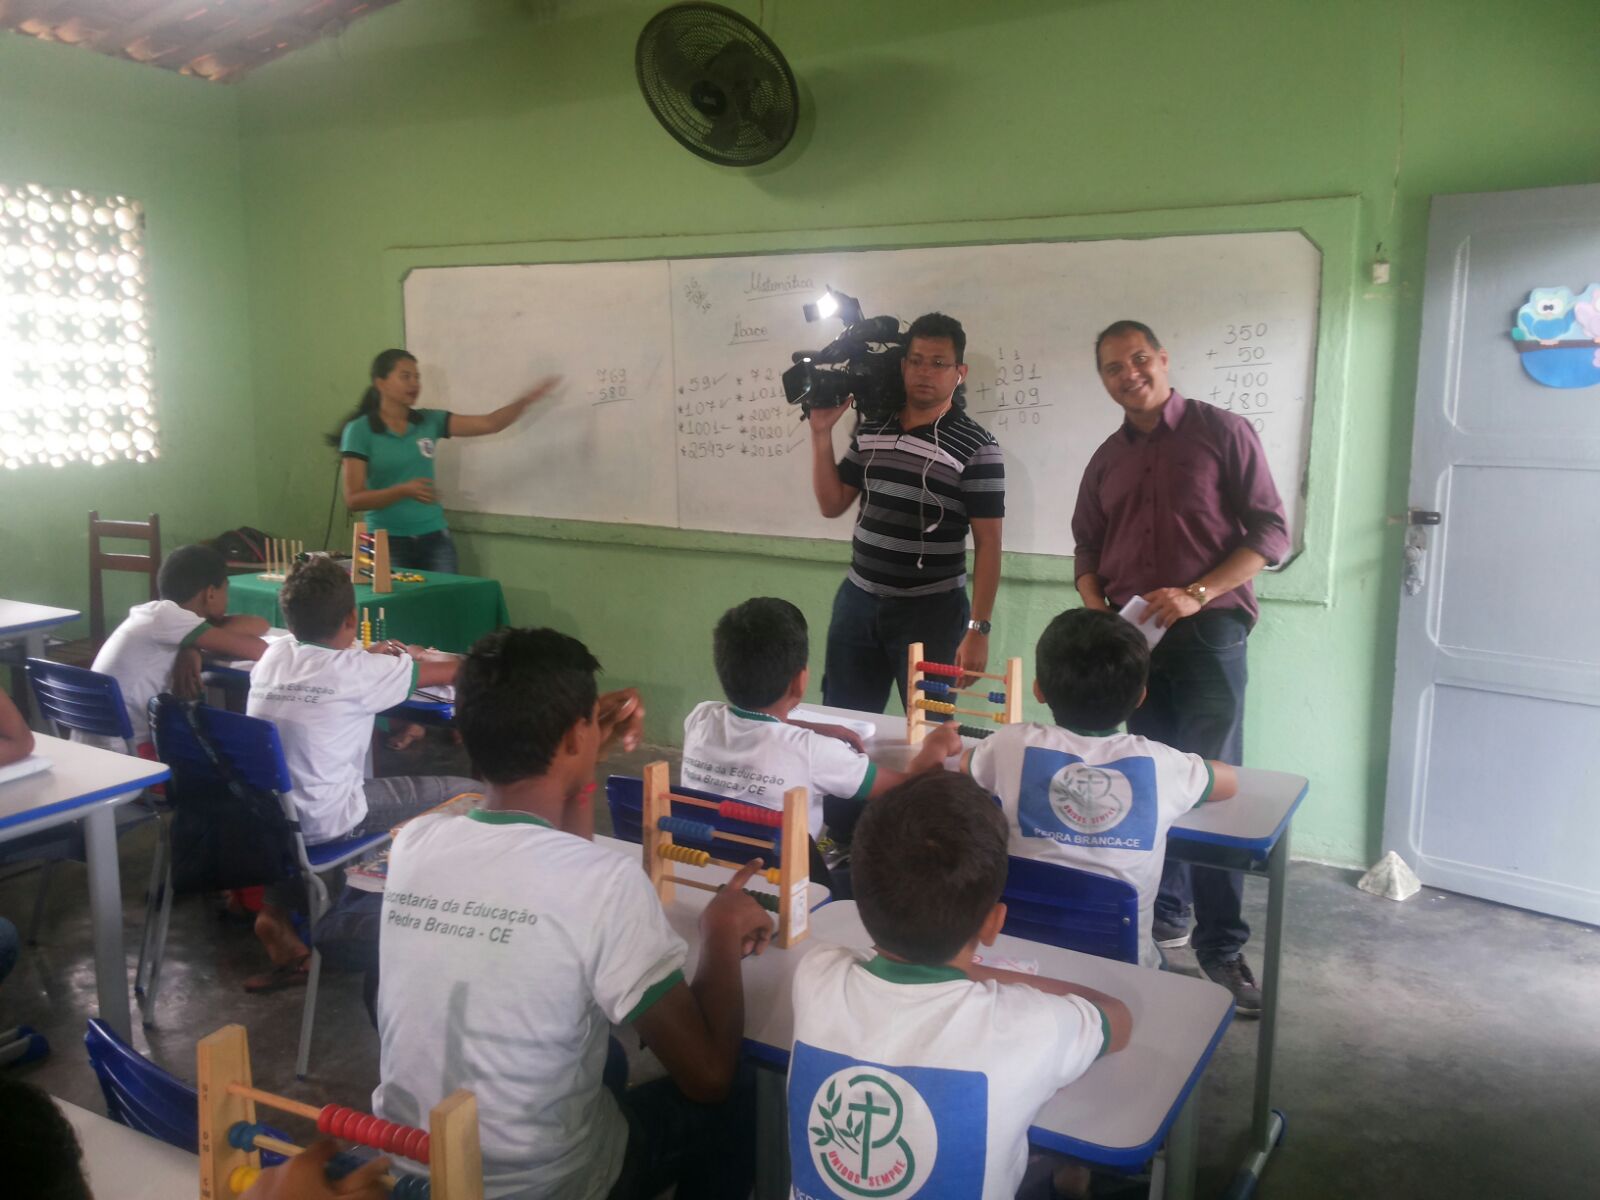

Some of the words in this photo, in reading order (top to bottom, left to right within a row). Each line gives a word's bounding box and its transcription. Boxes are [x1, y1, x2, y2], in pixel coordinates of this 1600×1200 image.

[1223, 322, 1268, 344] 350
[1238, 346, 1265, 362] 50
[995, 363, 1042, 386] 291
[1226, 371, 1269, 388] 400
[998, 387, 1040, 407] 109
[750, 406, 783, 421] 2007
[998, 411, 1040, 431] 400
[686, 420, 721, 436] 1001
[750, 427, 783, 441] 2020
[750, 445, 785, 458] 2016
[304, 695, 321, 704] CE
[703, 774, 740, 791] Branca
[748, 783, 767, 796] CE
[729, 766, 785, 786] Educação
[386, 888, 438, 911] ecretaria
[441, 897, 461, 914] da
[462, 900, 539, 927] Educação
[387, 909, 422, 930] Pedra
[424, 916, 477, 940] Branca
[489, 926, 514, 944] CE
[828, 1150, 861, 1185] UNIDOS
[867, 1159, 908, 1188] SEMPRE
